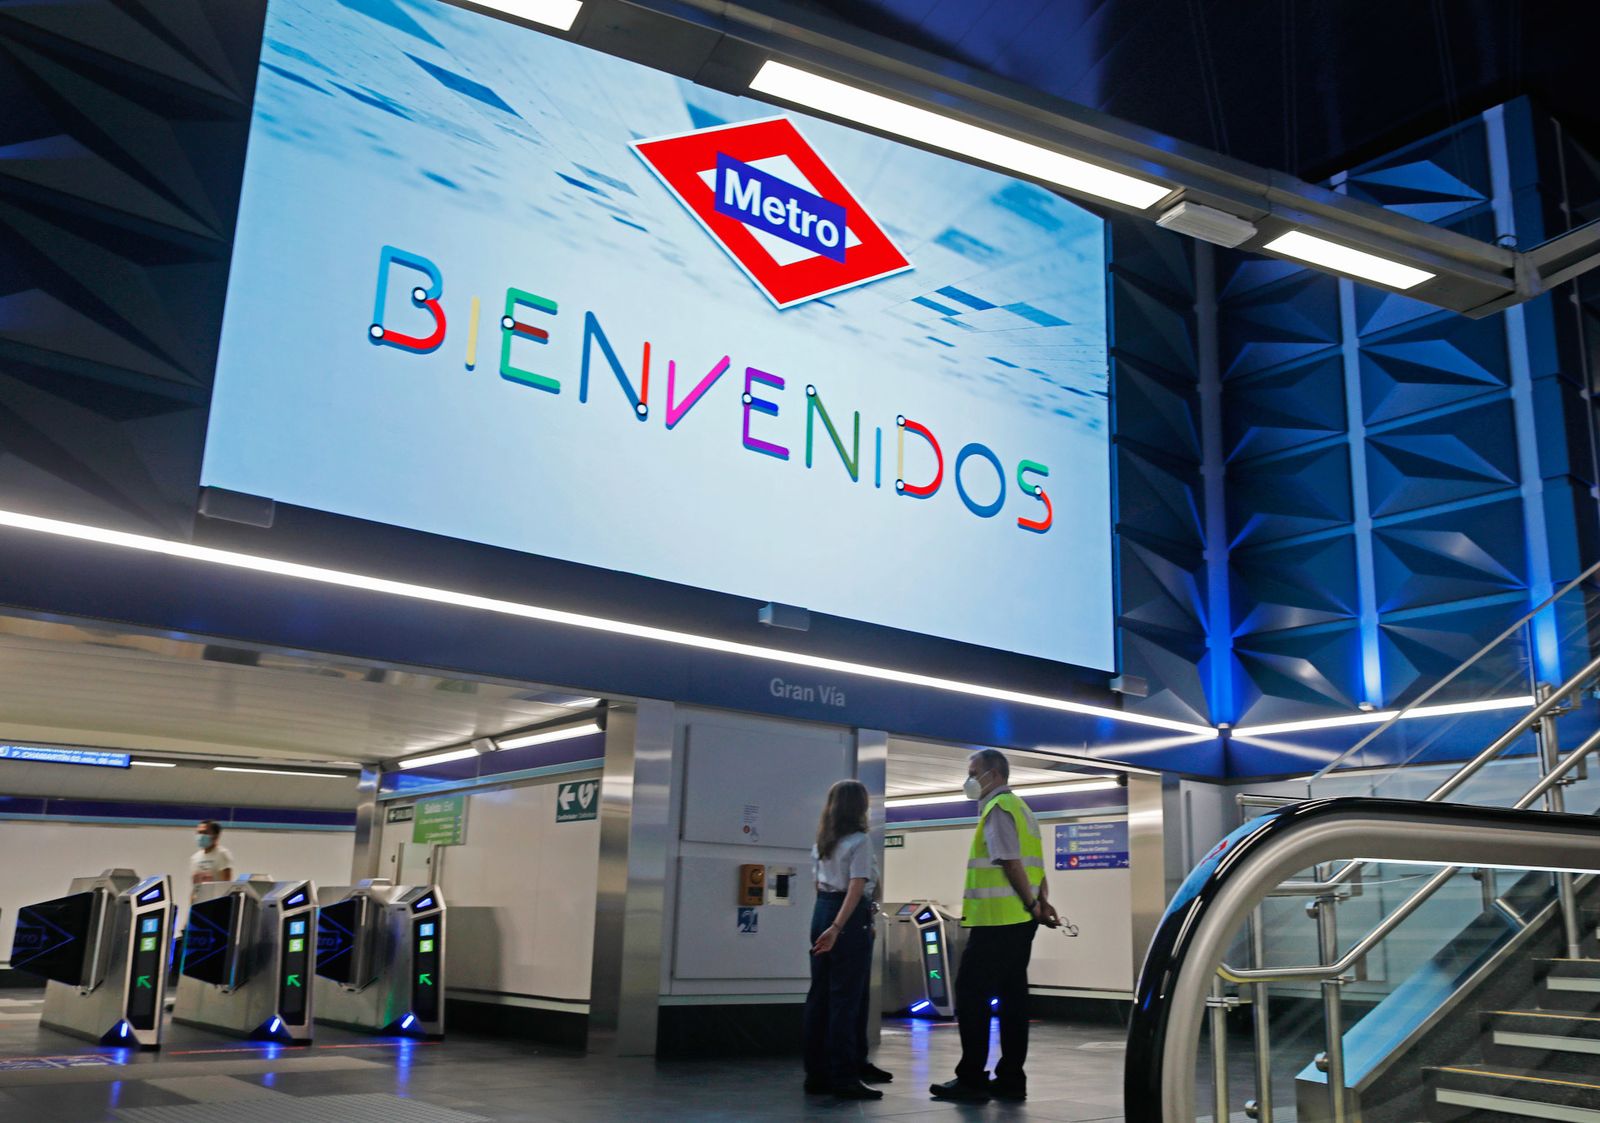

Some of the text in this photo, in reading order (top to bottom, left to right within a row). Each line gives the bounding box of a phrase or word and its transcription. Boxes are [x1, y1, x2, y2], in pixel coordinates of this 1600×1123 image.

[724, 168, 840, 248] Metro
[368, 244, 1054, 535] BIENVENIDOS
[769, 677, 846, 707] Gran Vía
